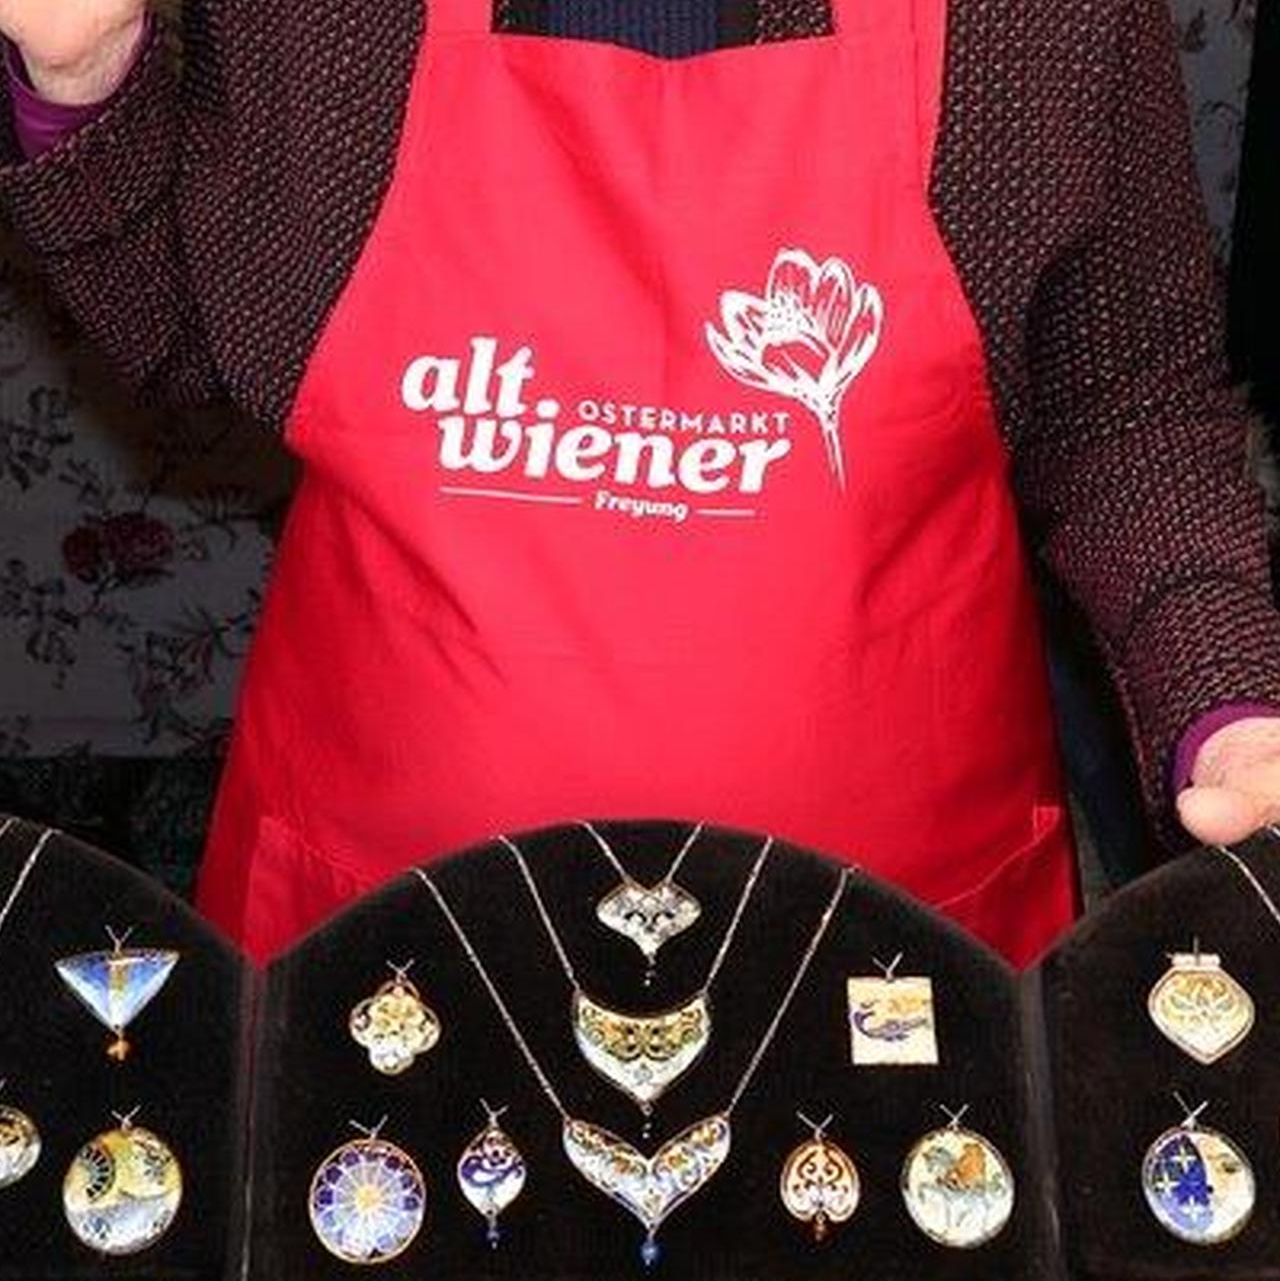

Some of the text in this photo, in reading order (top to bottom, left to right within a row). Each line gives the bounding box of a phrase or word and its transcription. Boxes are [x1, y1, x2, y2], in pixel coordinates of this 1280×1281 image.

[401, 336, 535, 418] alt
[578, 400, 790, 434] OSTERMARKT
[438, 399, 791, 494] wiener
[594, 489, 688, 521] Freyung
